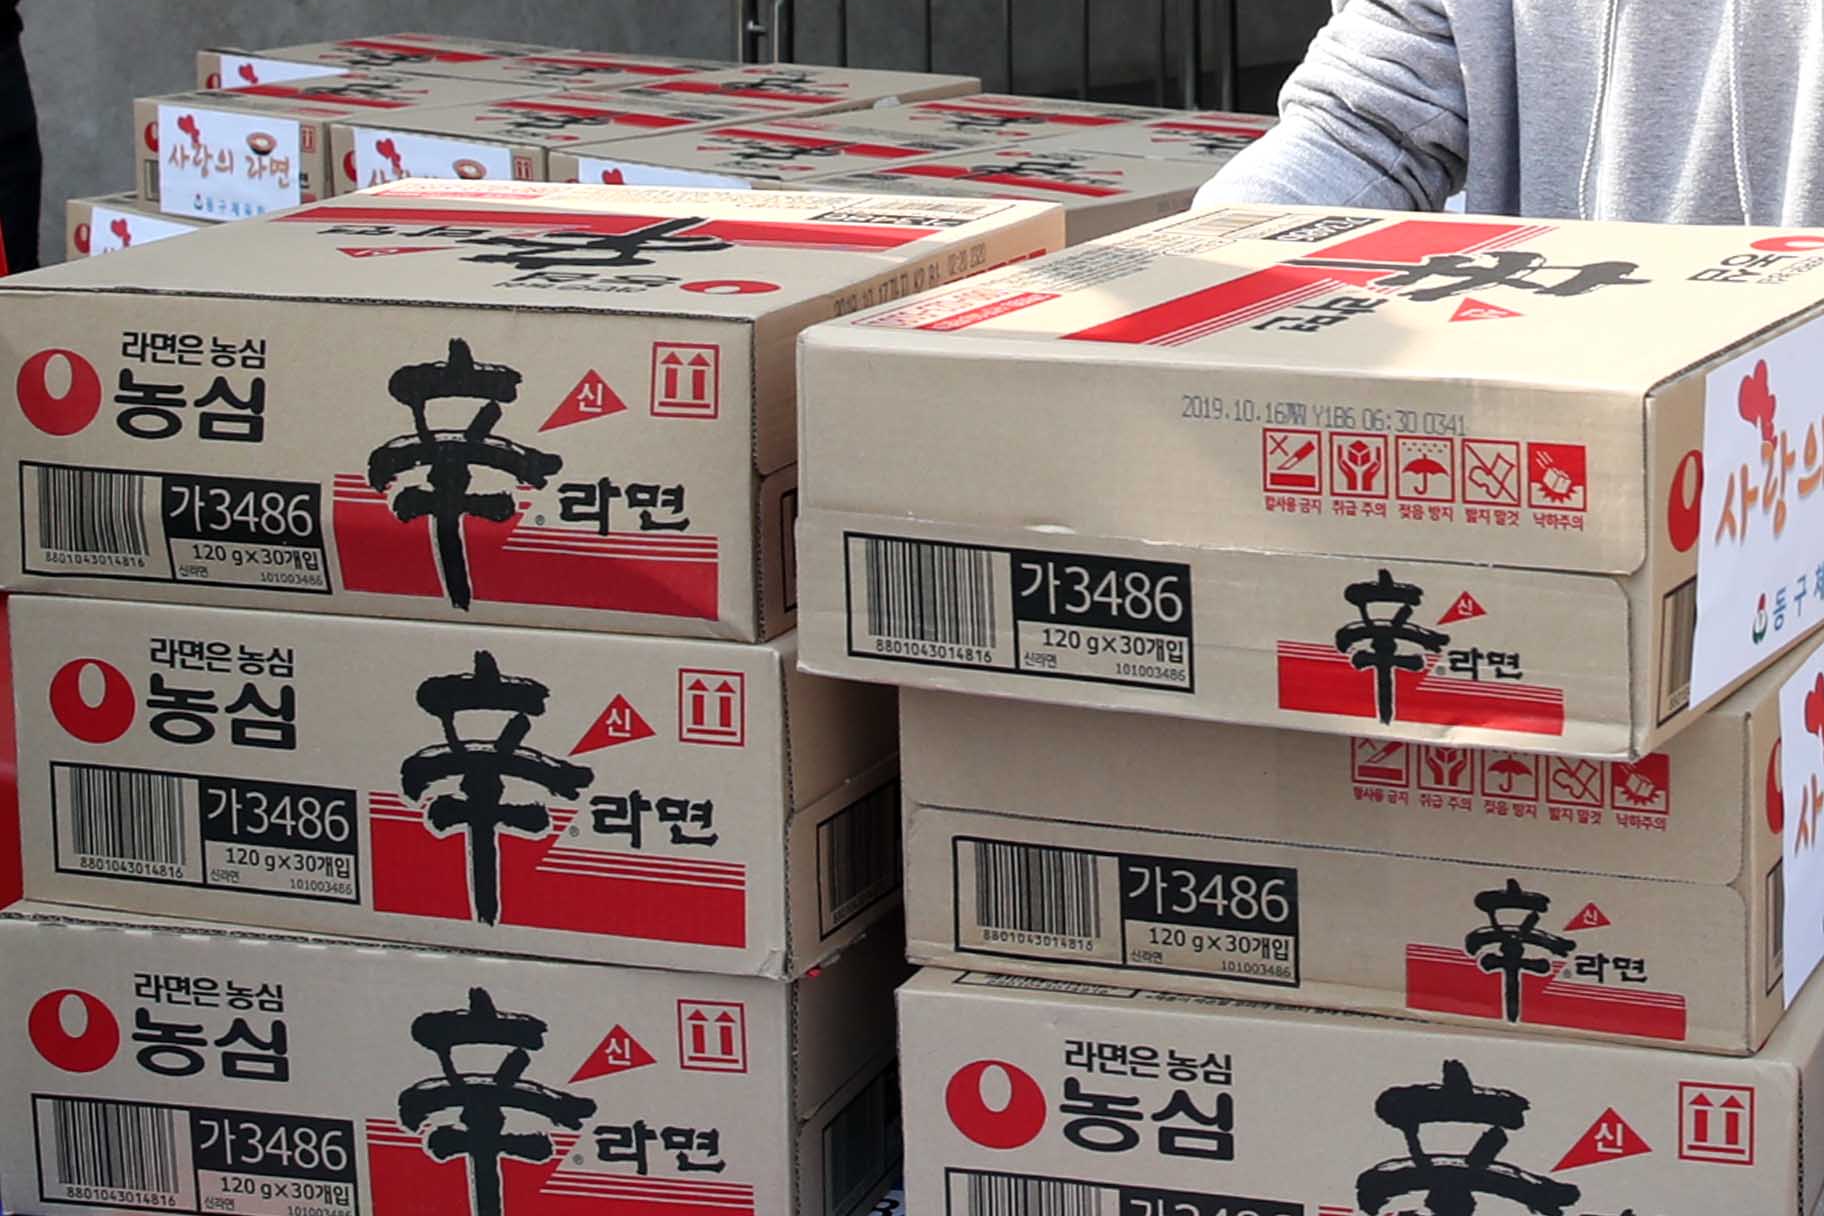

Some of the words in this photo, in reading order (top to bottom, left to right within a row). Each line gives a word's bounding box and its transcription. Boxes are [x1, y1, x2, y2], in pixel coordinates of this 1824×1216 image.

[168, 143, 234, 179] 사랑의
[245, 155, 290, 188] 라면
[121, 331, 204, 367] 라면은
[210, 336, 267, 370] 농심
[114, 368, 266, 442] 농심
[576, 384, 605, 413] 신
[1363, 408, 1417, 434] 06:30
[367, 338, 563, 611] 辛
[170, 485, 313, 536] 가3486
[556, 479, 690, 536] 라면
[1361, 501, 1387, 518] 주의
[45, 551, 146, 568] 8801043014816
[193, 544, 226, 563] 120
[1020, 561, 1183, 623] 가3486
[150, 638, 231, 673] 라면은
[237, 644, 294, 678] 농심
[875, 639, 993, 664] 8801043014816
[1042, 628, 1081, 650] 120
[1335, 569, 1450, 725] 辛
[1115, 663, 1186, 682] 101003486
[1447, 648, 1524, 681] 라면
[146, 673, 296, 750] 농심
[605, 707, 632, 738] 신
[401, 650, 595, 927] 辛
[207, 787, 349, 842] 가3486
[590, 789, 719, 848] 라면
[79, 857, 184, 879] 8801043014816
[225, 848, 260, 867] 120
[289, 878, 353, 896] 101003486
[1128, 865, 1289, 922] 가3486
[983, 929, 1094, 952] 8801043014816
[1149, 928, 1186, 947] 120
[1464, 878, 1577, 1023] 辛
[1221, 960, 1292, 979] 101003486
[1575, 952, 1647, 984] 라면
[134, 973, 219, 1008] 라면은
[226, 981, 283, 1013] 농심
[131, 1007, 290, 1082] 농심
[604, 1037, 632, 1066] 신
[1064, 1040, 1160, 1079] 라면은
[1167, 1049, 1233, 1086] 농심
[398, 986, 597, 1216] 辛
[1059, 1077, 1235, 1161] 농심
[200, 1120, 348, 1172] 가3486
[593, 1119, 726, 1175] 라면
[1594, 1123, 1623, 1153] 신
[66, 1186, 177, 1208] 8801043014816
[220, 1176, 255, 1195] 120
